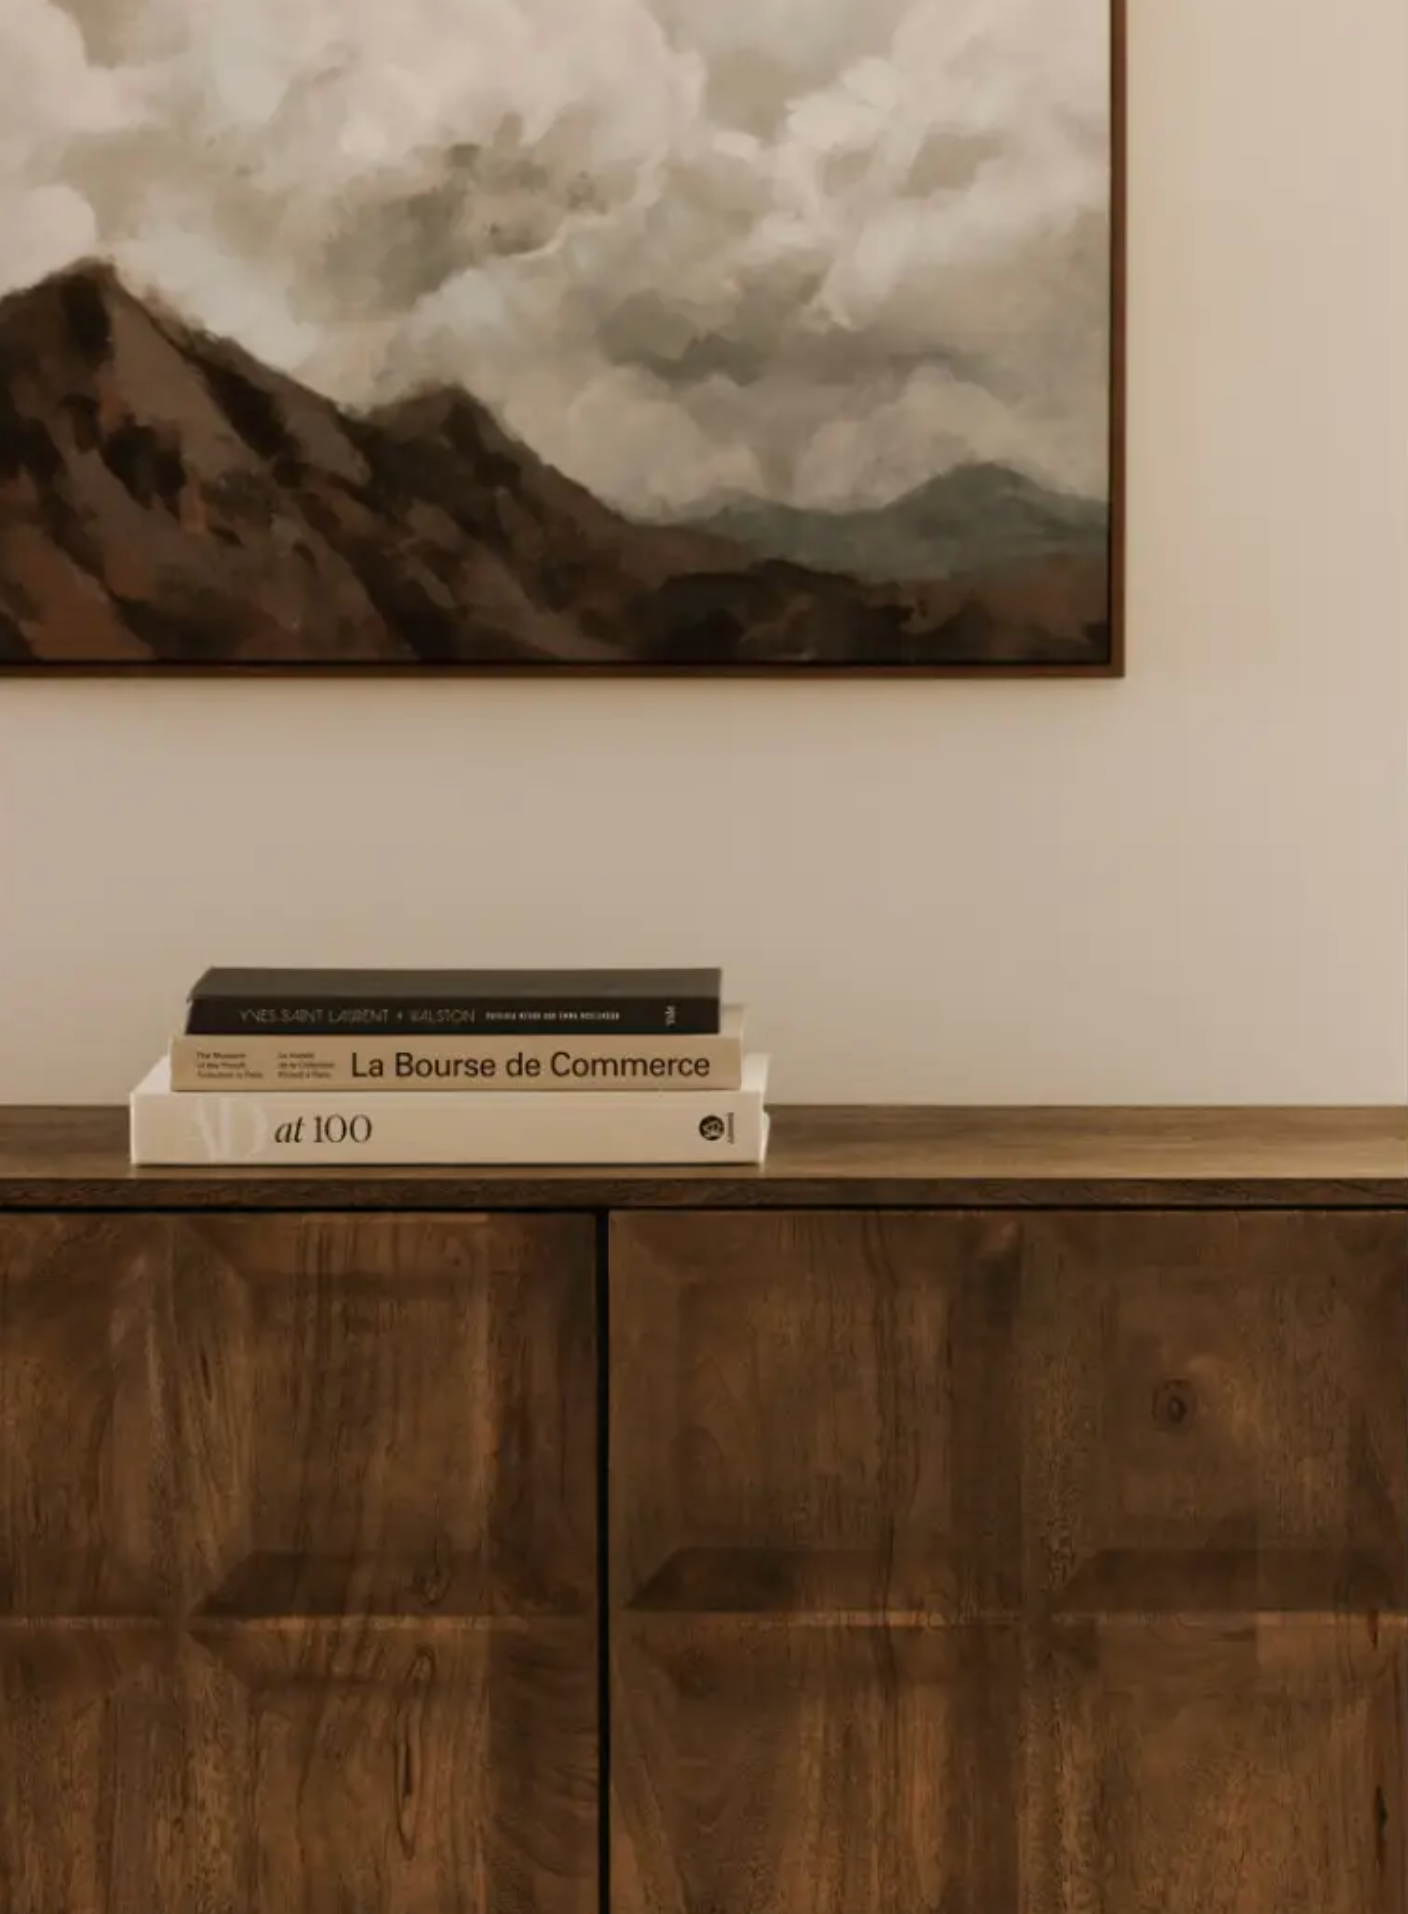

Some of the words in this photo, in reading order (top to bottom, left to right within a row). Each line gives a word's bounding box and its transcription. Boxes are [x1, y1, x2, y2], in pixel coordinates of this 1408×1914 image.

[239, 1008, 275, 1024] YVES
[281, 1008, 324, 1024] SAINT
[351, 1052, 384, 1078] La
[395, 1051, 497, 1078] Bourse
[505, 1051, 541, 1078] de
[550, 1051, 711, 1078] Commerce
[274, 1115, 305, 1144] at
[312, 1113, 373, 1144] 100
